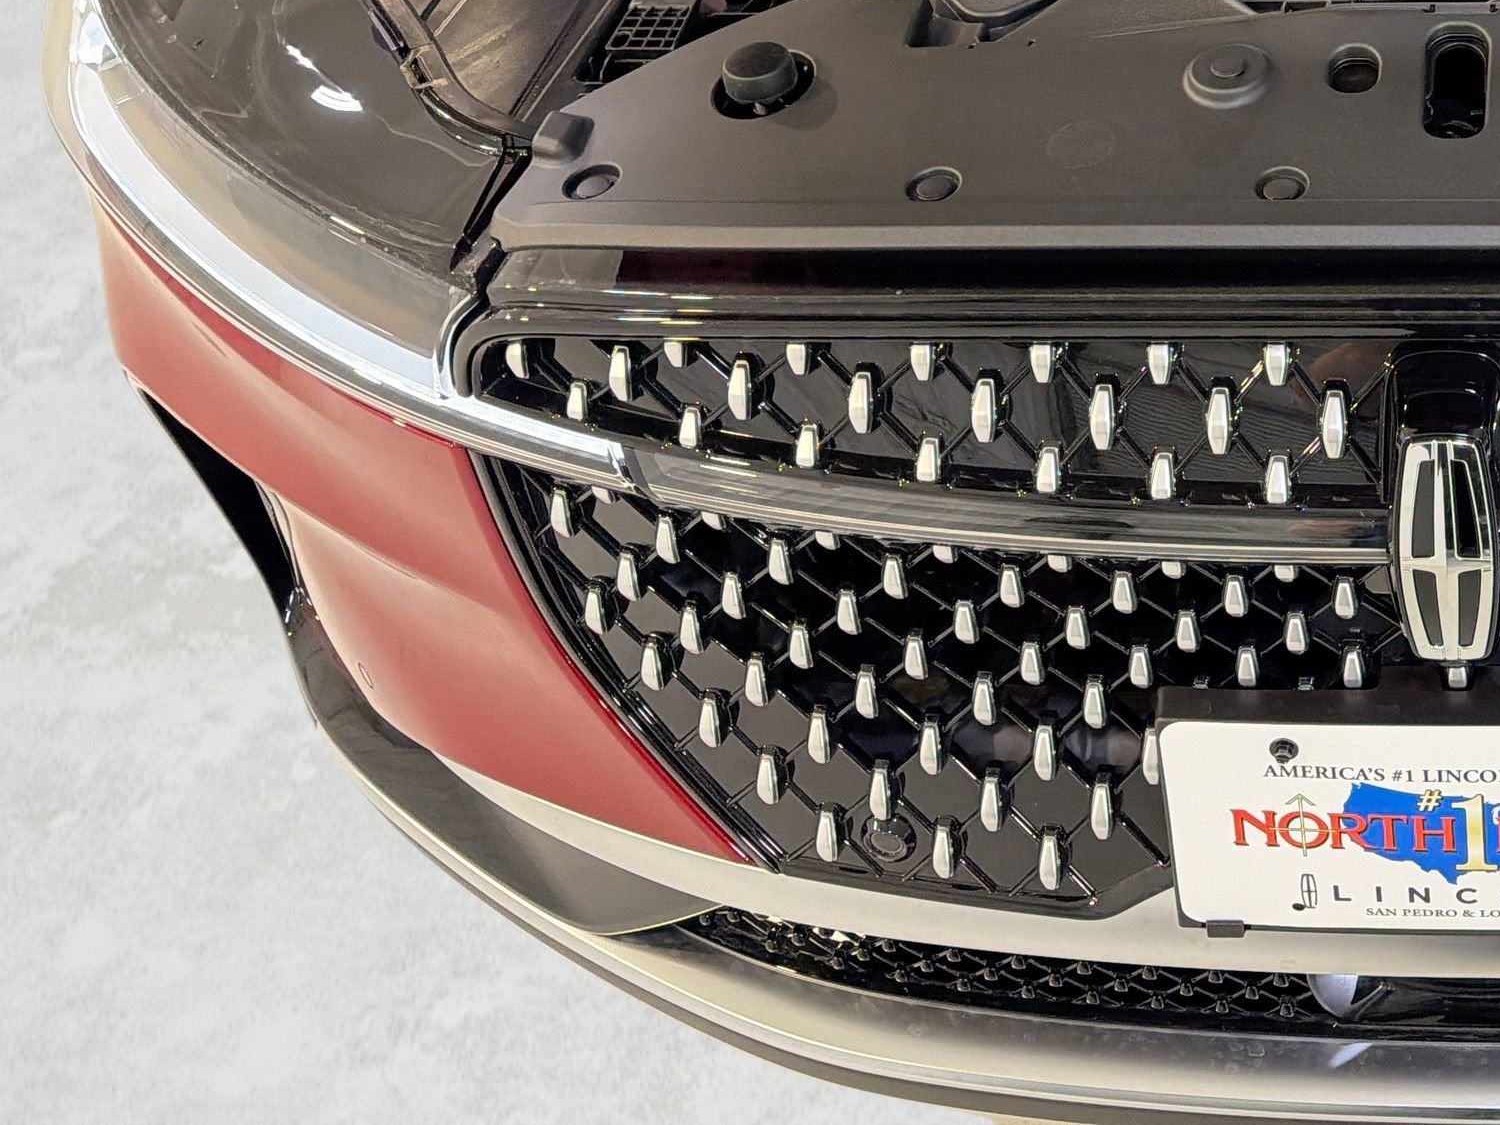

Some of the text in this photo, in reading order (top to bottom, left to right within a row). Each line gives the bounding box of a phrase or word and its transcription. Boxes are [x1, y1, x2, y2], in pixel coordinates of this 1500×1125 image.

[1263, 764, 1386, 782] AMERICA'S
[1392, 769, 1416, 783] #1
[1230, 808, 1458, 853] NORTH
[1366, 907, 1397, 917] SAN
[1403, 908, 1458, 918] PEDRO
[1462, 909, 1475, 918] &
